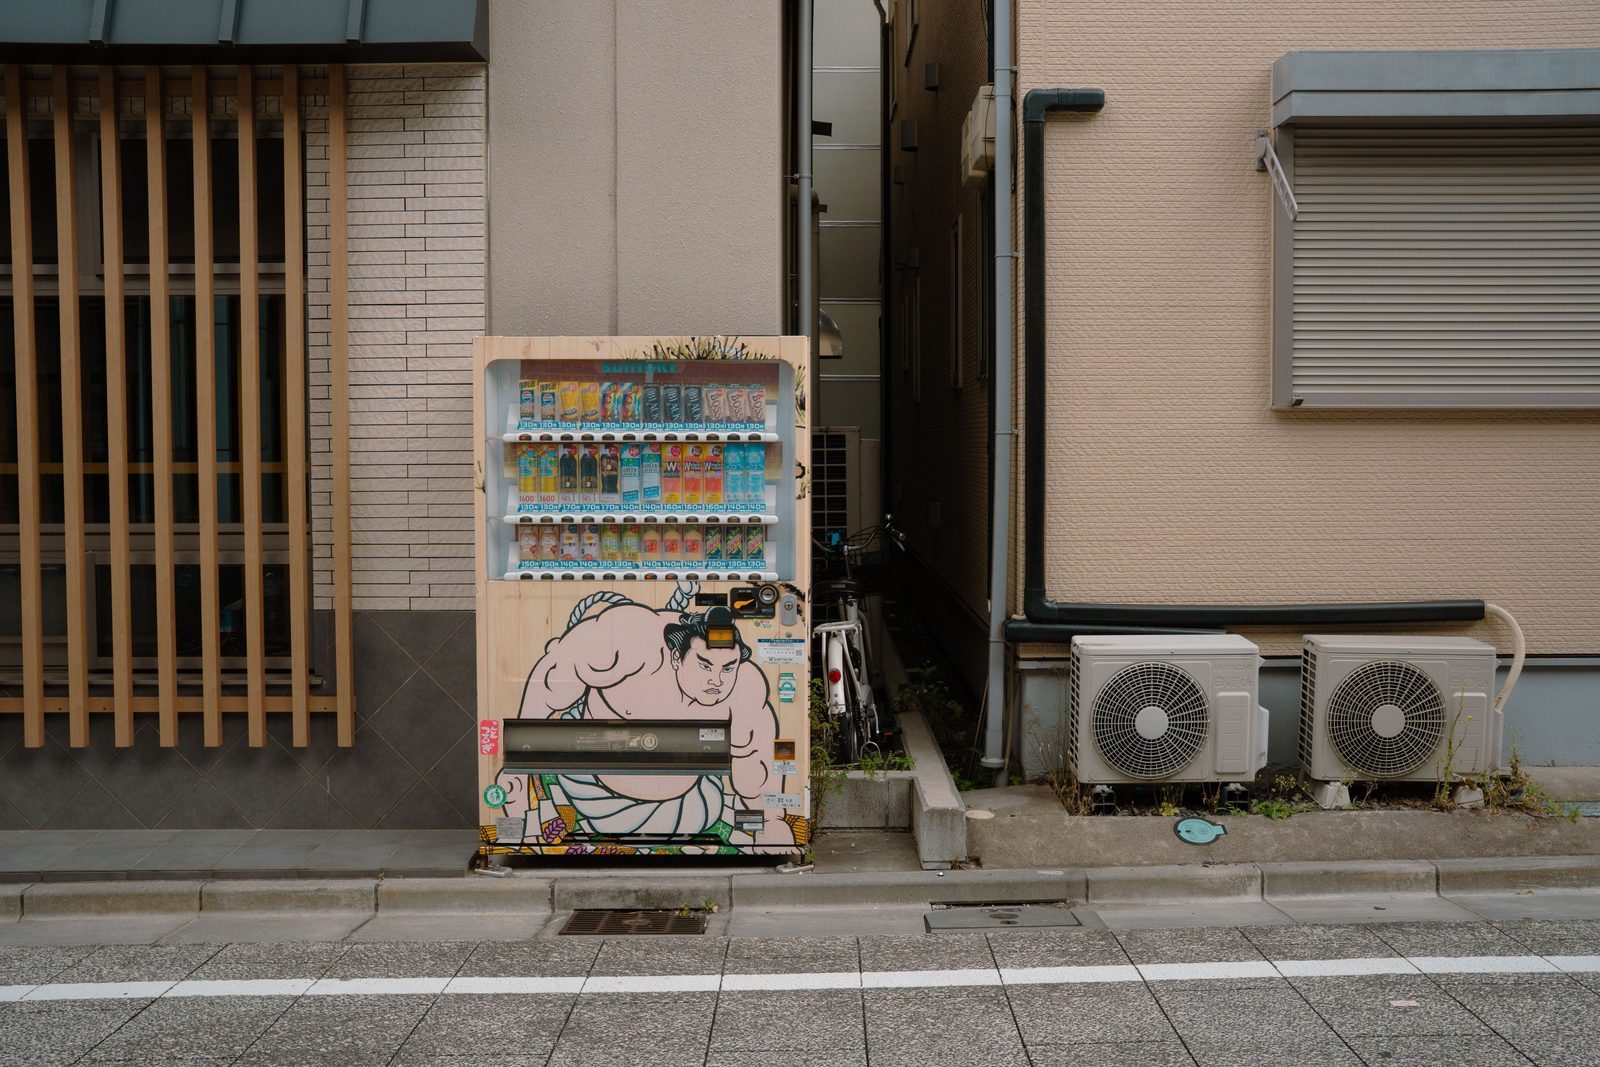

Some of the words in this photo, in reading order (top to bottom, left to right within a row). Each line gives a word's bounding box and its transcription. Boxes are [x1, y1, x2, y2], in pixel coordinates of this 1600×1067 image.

[602, 361, 677, 373] SUNTORY
[646, 388, 659, 420] BLACK
[666, 388, 680, 420] BLACK
[687, 388, 702, 420] BLACK
[710, 394, 722, 420] BOSS
[731, 395, 743, 420] BOSS
[752, 395, 764, 420] BOSS
